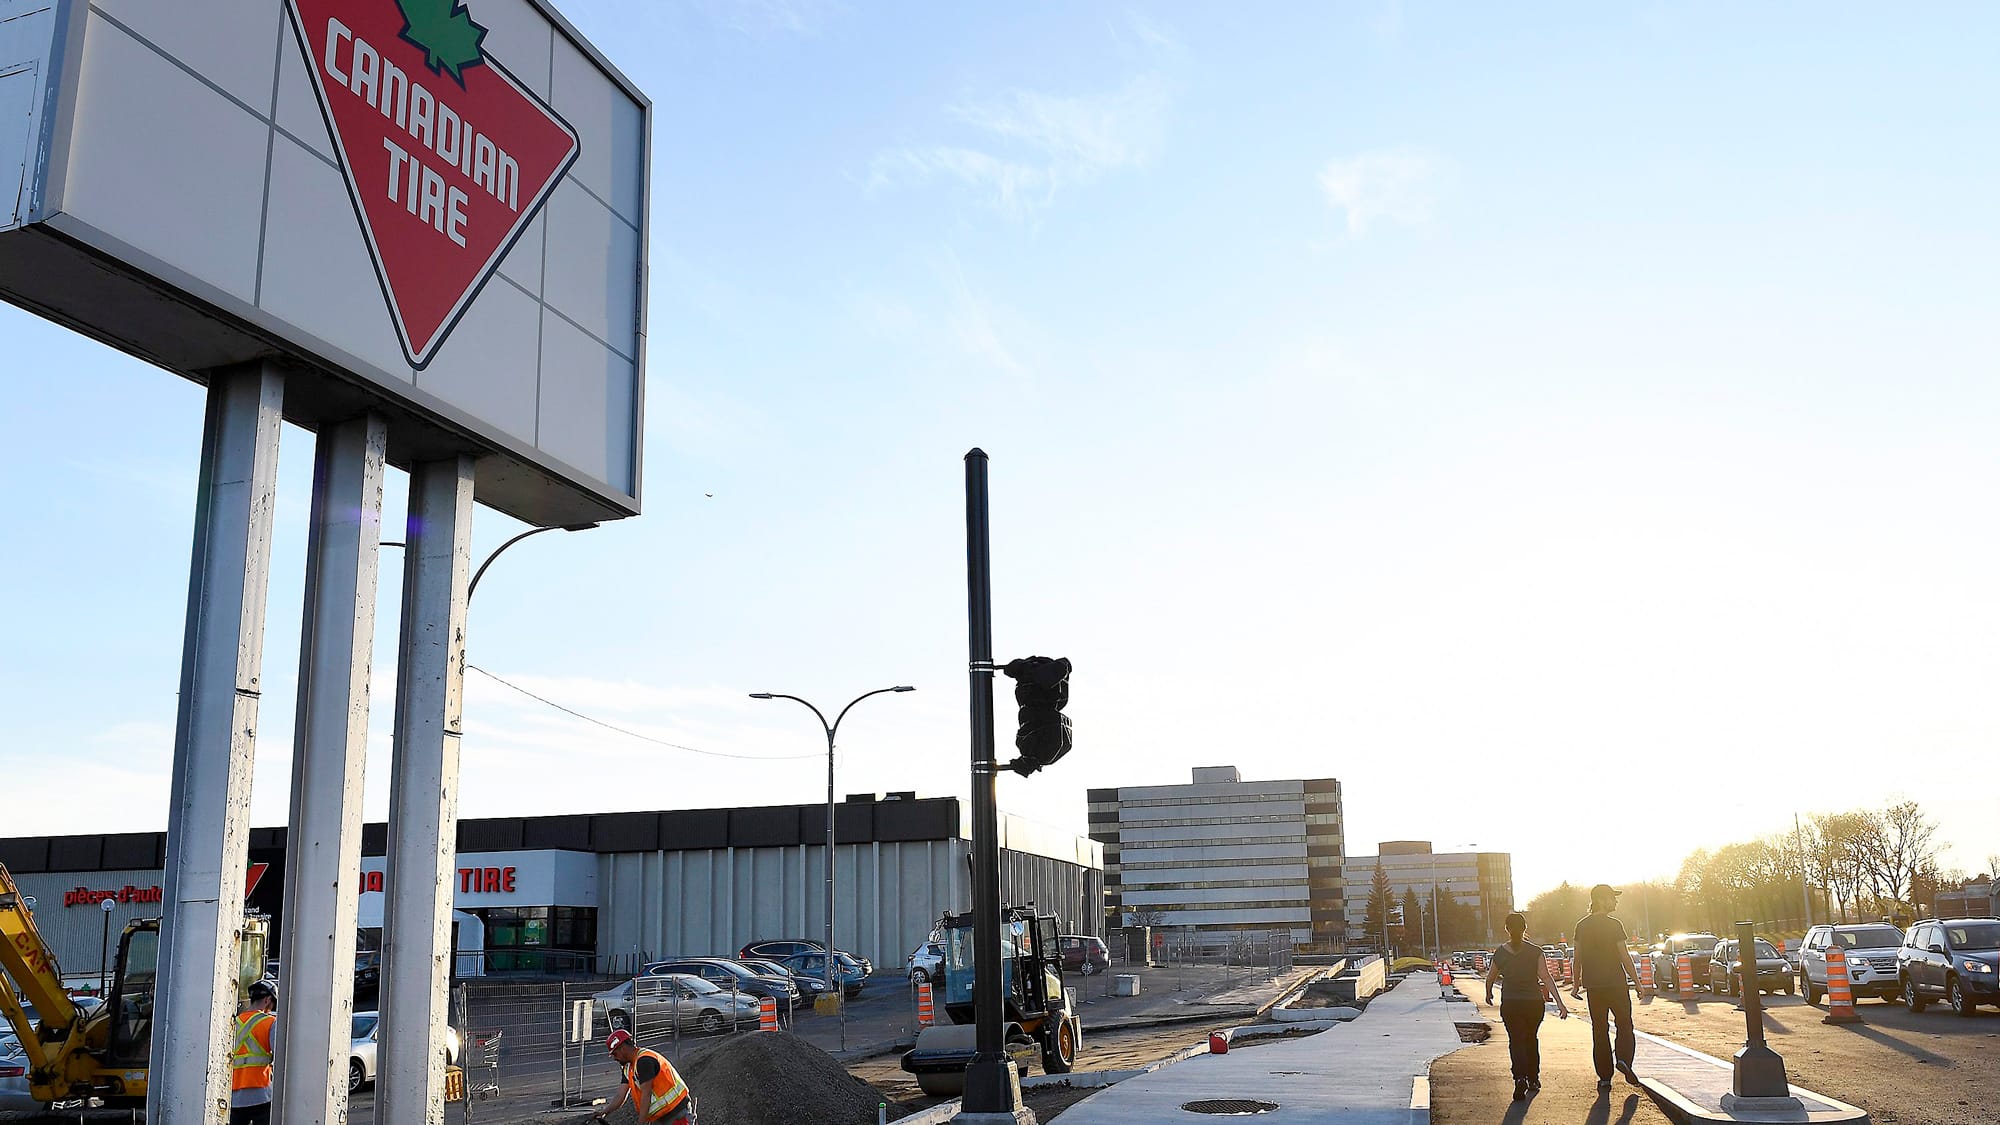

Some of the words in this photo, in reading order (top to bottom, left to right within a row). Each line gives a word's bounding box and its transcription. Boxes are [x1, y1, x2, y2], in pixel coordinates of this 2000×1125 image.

[324, 17, 519, 213] CANADIAN
[383, 136, 469, 249] TIRE
[64, 887, 116, 907] pièces
[458, 867, 516, 893] TIRE
